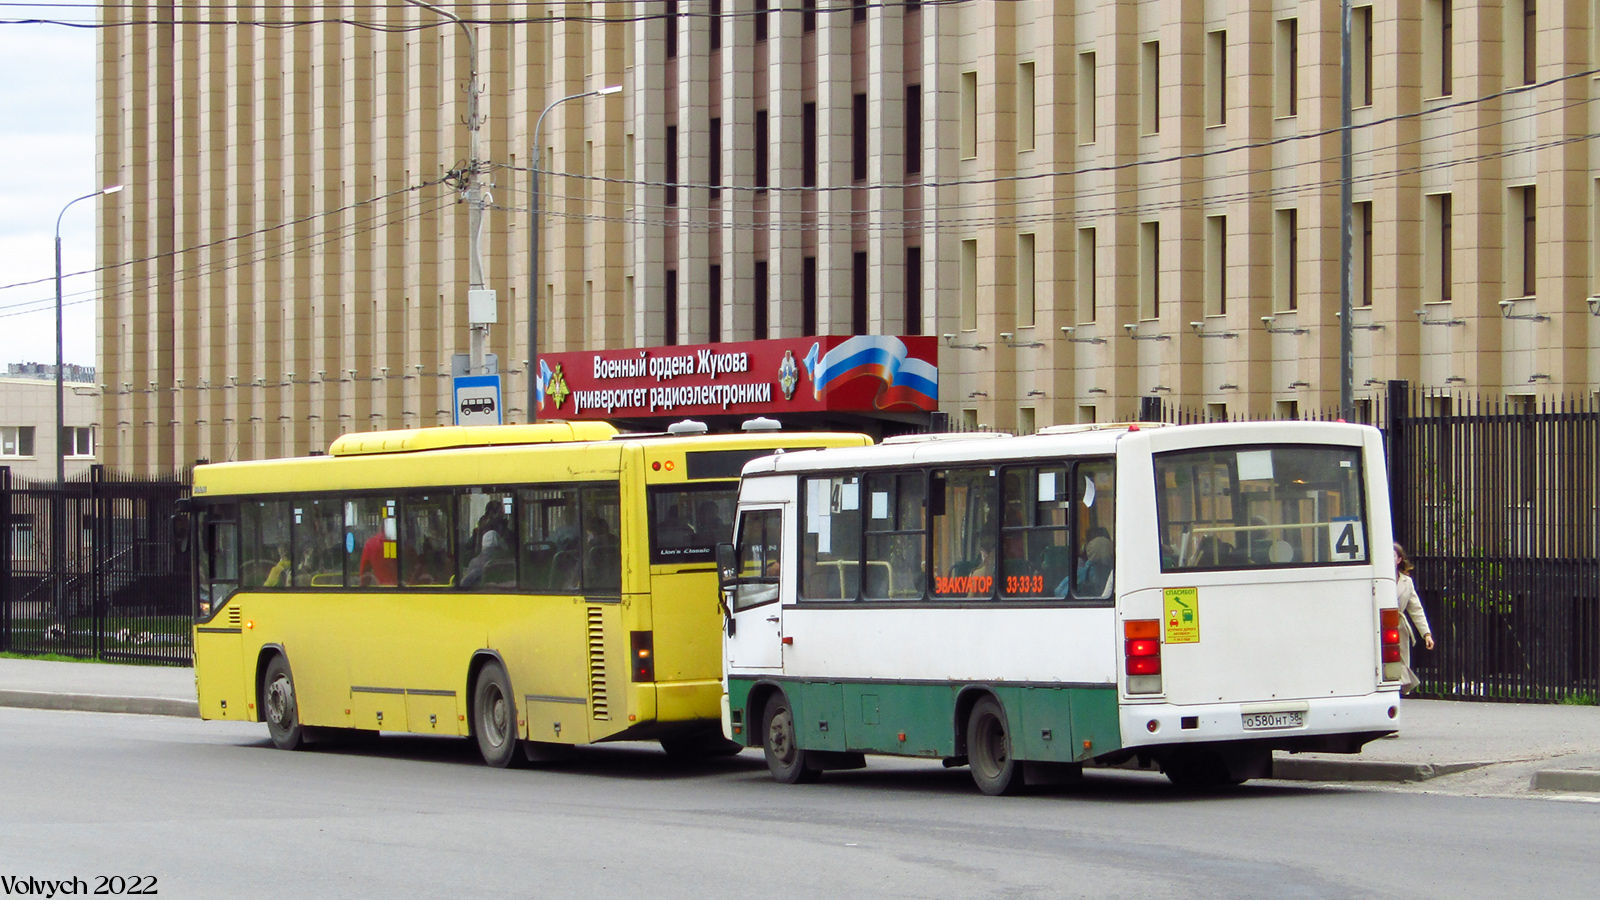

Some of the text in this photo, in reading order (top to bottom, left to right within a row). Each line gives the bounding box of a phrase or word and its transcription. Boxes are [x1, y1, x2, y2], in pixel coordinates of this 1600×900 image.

[593, 349, 747, 382] Военный ордена Жукова
[573, 382, 771, 414] университет радиоэлектроники
[1335, 523, 1359, 559] 4
[935, 576, 993, 594] ЭВАКУАТОР
